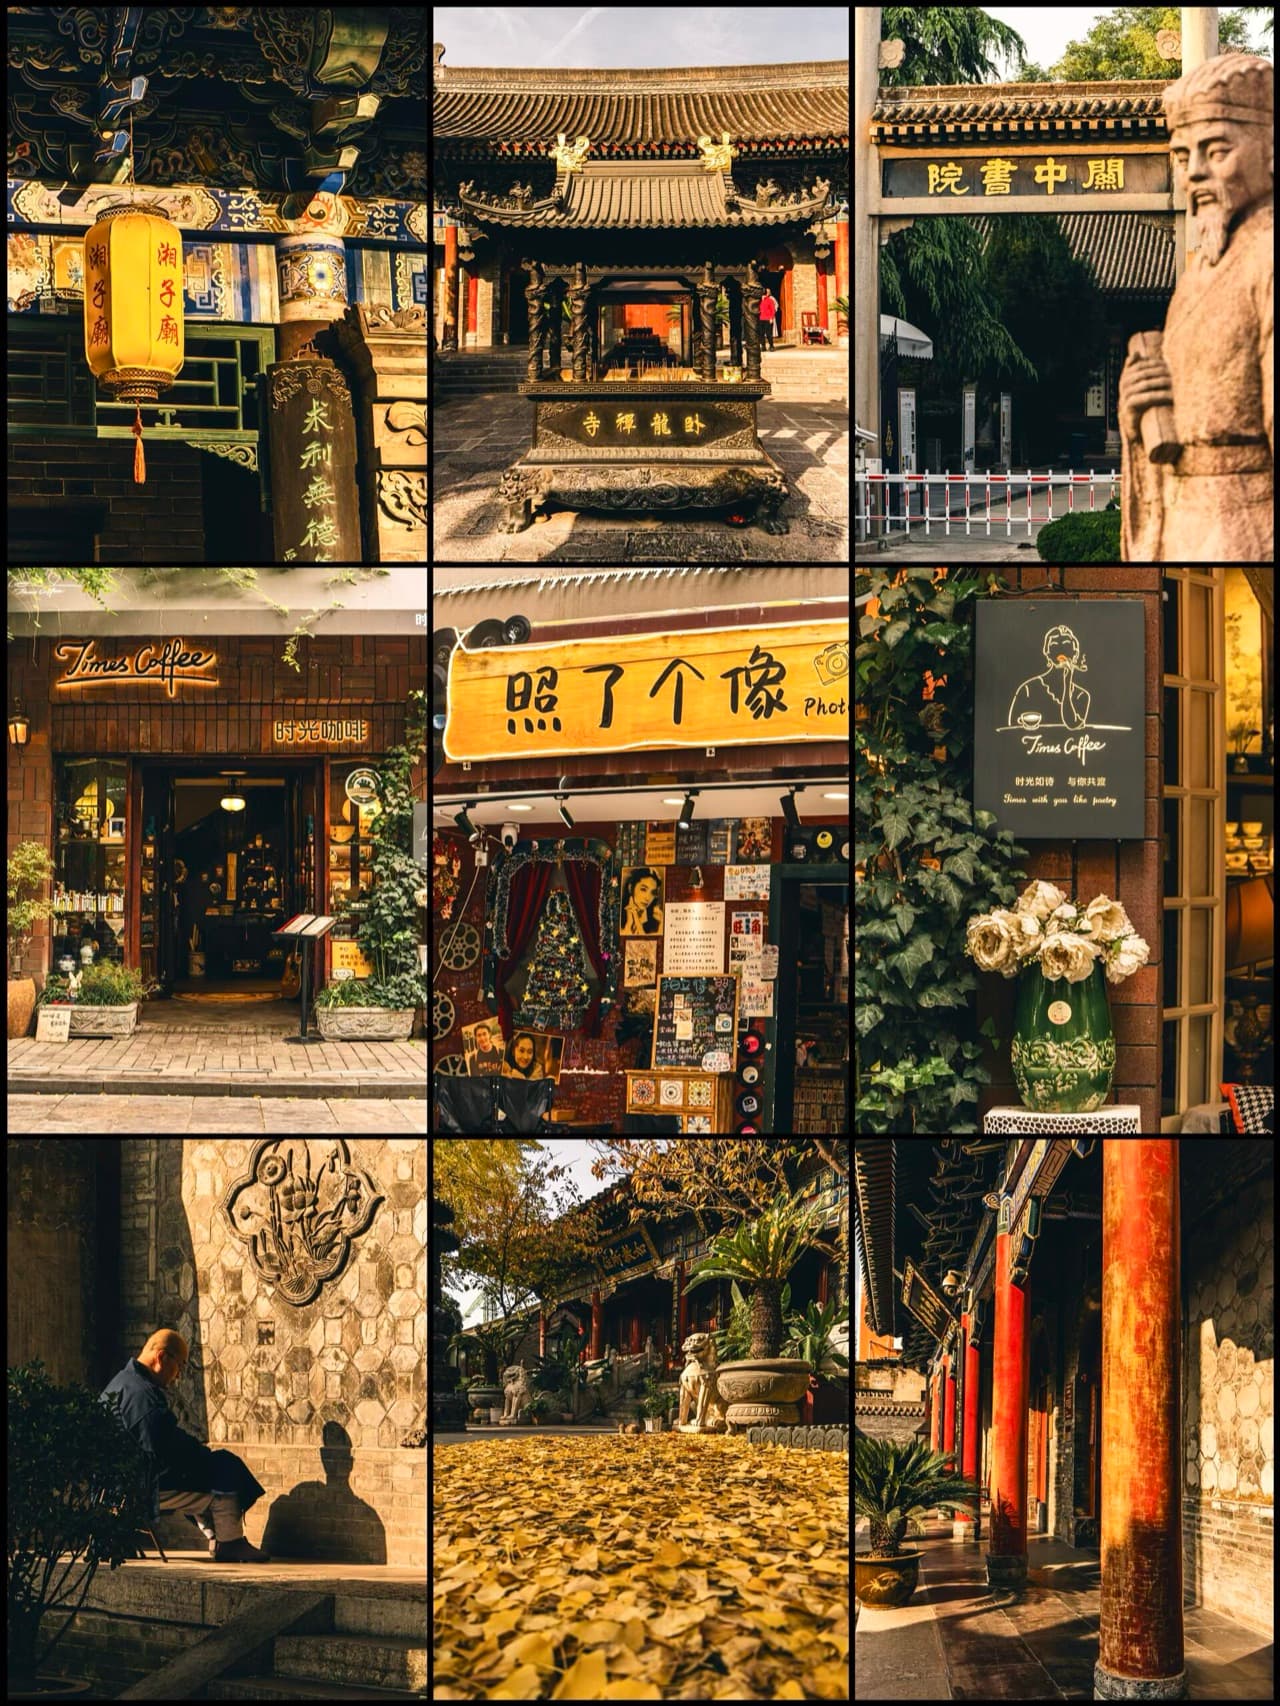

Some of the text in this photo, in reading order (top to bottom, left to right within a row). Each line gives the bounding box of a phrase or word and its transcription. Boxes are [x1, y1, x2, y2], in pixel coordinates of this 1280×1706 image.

[156, 242, 180, 347] 湘子廟
[57, 638, 215, 697] Times Coffee
[506, 645, 788, 734] 照了个像
[804, 697, 849, 717] Phot
[276, 720, 367, 742] 时光咖啡
[1021, 734, 1106, 766] Times Coffee
[1032, 794, 1048, 804] with
[1053, 797, 1067, 806] you
[1074, 794, 1087, 804] like
